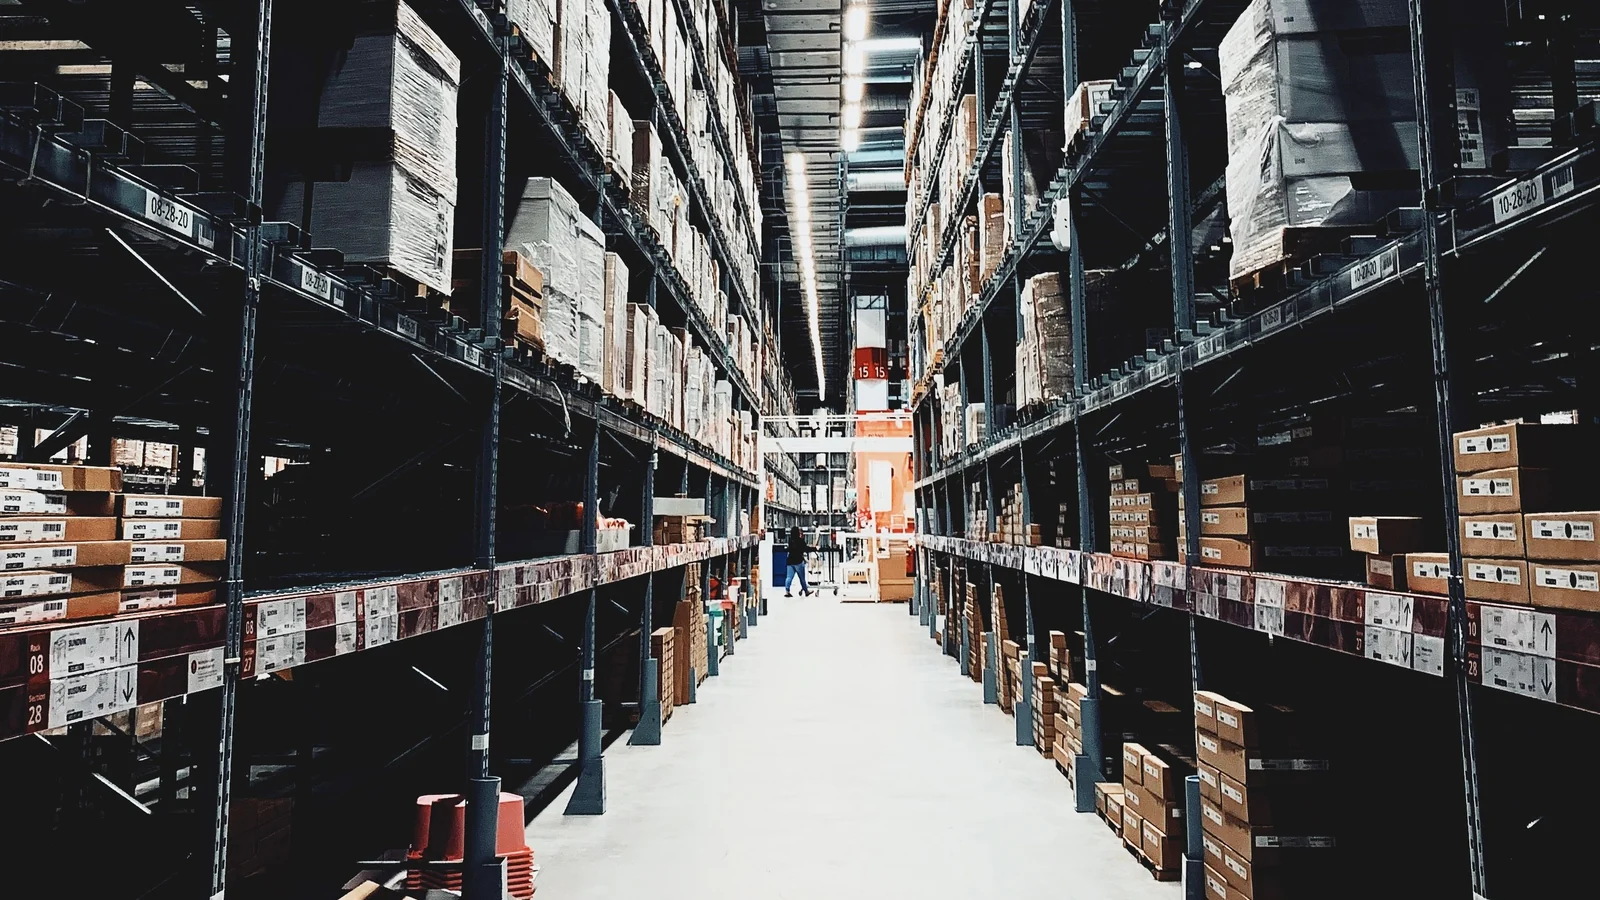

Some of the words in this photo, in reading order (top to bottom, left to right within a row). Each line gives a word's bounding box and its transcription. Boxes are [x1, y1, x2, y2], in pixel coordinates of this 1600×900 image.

[1498, 182, 1538, 215] 10-28-20
[151, 197, 188, 229] 08-28-20
[1354, 260, 1377, 283] 10-27-20
[305, 272, 327, 294] 08-27-20
[858, 366, 869, 378] 15
[875, 366, 885, 378] 15
[245, 620, 254, 635] 08
[1468, 621, 1477, 637] 10
[30, 644, 41, 652] Rack
[30, 654, 44, 675] 08
[243, 657, 253, 672] 27
[1468, 660, 1478, 676] 28
[28, 693, 46, 703] Section
[28, 705, 42, 725] 28
